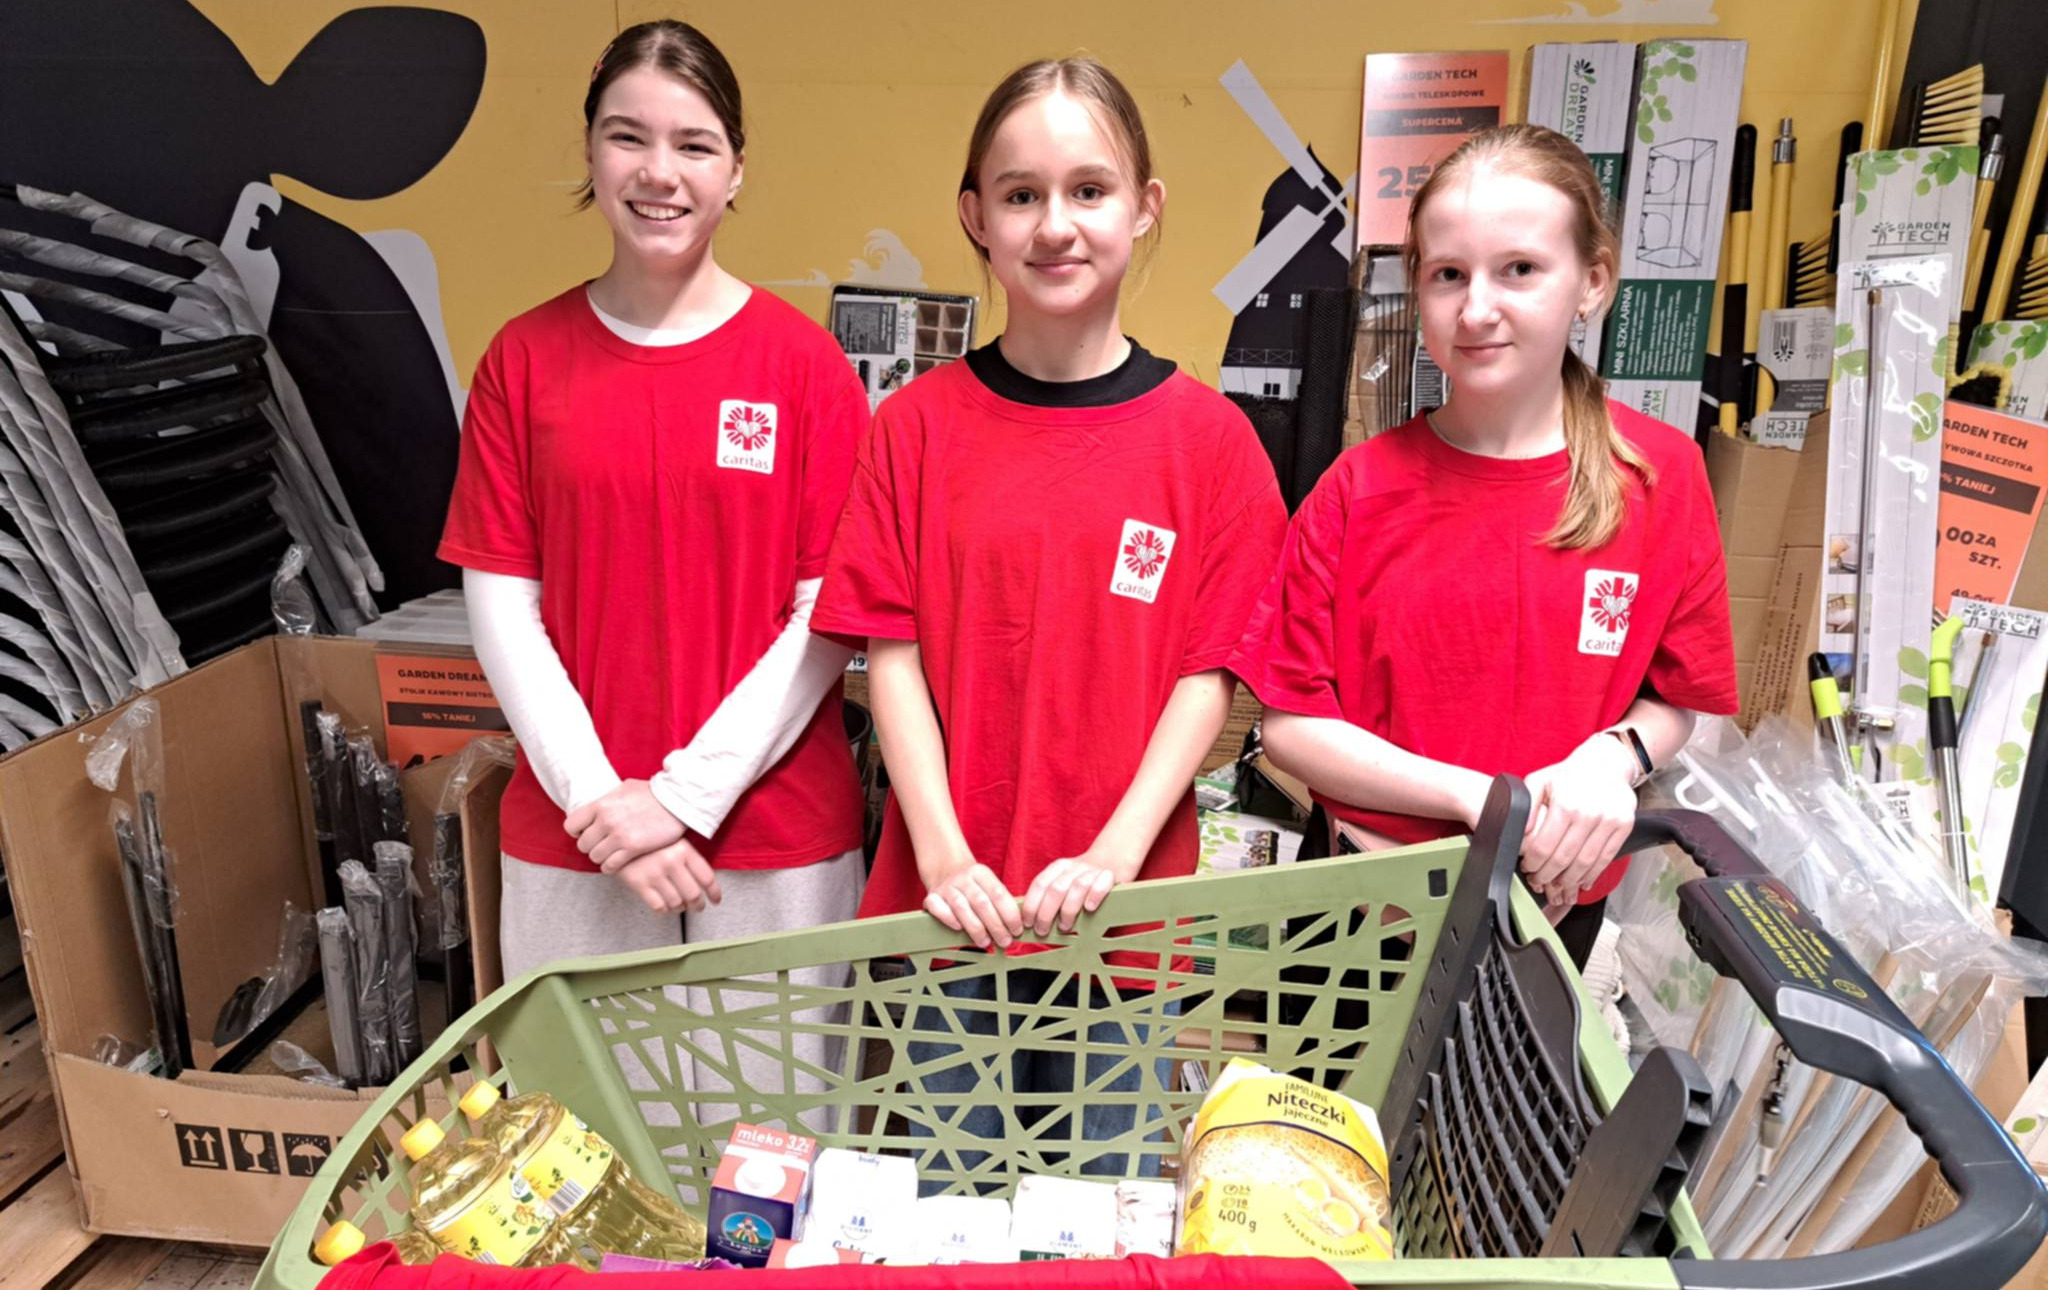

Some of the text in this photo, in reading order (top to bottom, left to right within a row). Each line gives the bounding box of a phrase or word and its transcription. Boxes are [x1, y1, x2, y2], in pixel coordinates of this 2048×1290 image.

[1445, 68, 1478, 80] TECH
[1575, 85, 1589, 143] GARDEN
[1897, 221, 1951, 230] GARDEN
[1897, 230, 1950, 242] TECH
[1613, 285, 1634, 375] MINI SZKLARNIA
[1766, 421, 1805, 431] TECH
[1943, 419, 2029, 450] ARDEN TECH
[722, 455, 769, 470] caritas
[1984, 453, 2033, 473] SZCZOTKA
[1954, 476, 1996, 495] TANIEJ
[1975, 533, 1997, 548] ZA
[1968, 551, 2002, 569] SZT.
[1989, 616, 2041, 636] TECH
[398, 669, 445, 679] GARDEN
[443, 712, 476, 723] TANIEJ
[1267, 1091, 1346, 1126] Niteczki
[1283, 1106, 1329, 1128] jajeczne
[738, 1129, 784, 1147] mleko
[1218, 1209, 1257, 1233] 400 g
